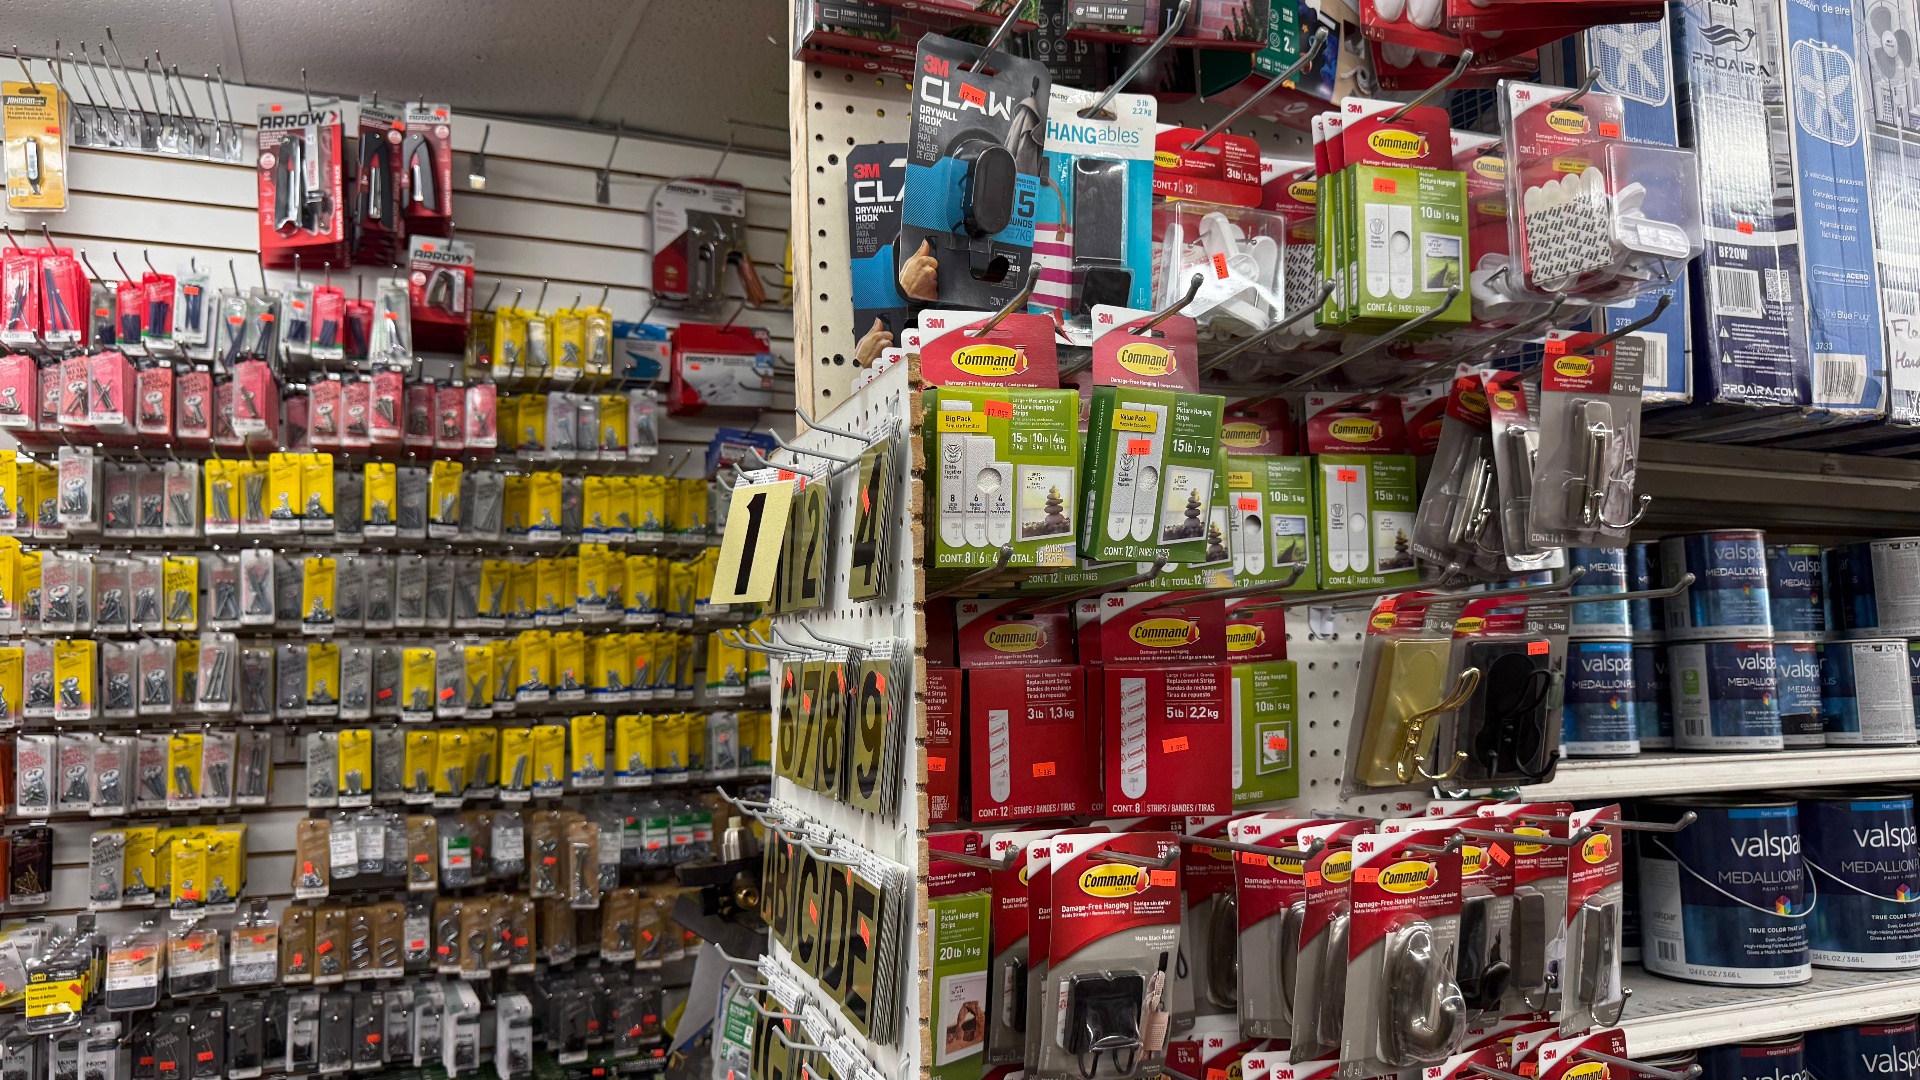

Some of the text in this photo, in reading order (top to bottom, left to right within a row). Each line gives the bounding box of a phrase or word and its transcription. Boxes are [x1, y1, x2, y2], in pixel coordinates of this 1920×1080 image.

[1822, 4, 1832, 14] de
[1834, 4, 1850, 16] aire
[924, 55, 950, 78] 3M
[1692, 52, 1771, 77] PROAIRA
[1516, 90, 1530, 100] 3M
[920, 104, 958, 122] DRYWALL
[1144, 108, 1152, 116] kg
[1348, 104, 1362, 114] 3M
[260, 111, 327, 130] ARROW
[919, 113, 942, 128] HOOK
[1550, 114, 1584, 128] Command
[1046, 118, 1140, 145] HANGables
[1372, 136, 1420, 151] Command
[1362, 159, 1391, 167] Damage-Free
[854, 163, 880, 178] 3M
[1152, 179, 1193, 194] CONT. 7 12
[1420, 177, 1436, 185] Picture
[855, 205, 894, 214] DRYWALL
[1420, 206, 1433, 218] 10
[1434, 208, 1441, 218] lb
[1450, 213, 1459, 222] kg
[856, 214, 879, 222] HOOK
[856, 222, 876, 230] GANCHO
[1015, 228, 1032, 242] 7KG
[414, 250, 464, 262] ARROW
[1718, 246, 1748, 261] BF20W
[1846, 273, 1869, 281] ACERO
[926, 318, 945, 329] 3M
[1098, 313, 1113, 324] 3M
[1815, 342, 1833, 350] 3733
[958, 352, 1016, 367] Command
[1121, 350, 1168, 366] Command
[1556, 360, 1588, 371] Command
[982, 380, 1004, 388] Hanging
[1111, 377, 1139, 385] Damage-Free
[1722, 383, 1797, 397] PROAIRA.COM
[1310, 397, 1323, 406] 3M
[1176, 414, 1190, 422] Strips
[1194, 408, 1212, 417] Hanging
[1220, 428, 1261, 440] Command
[1332, 424, 1374, 435] Command
[1012, 433, 1022, 443] 15
[1033, 433, 1043, 442] 10
[1053, 433, 1059, 443] 4
[1172, 439, 1210, 455] 15 lb 7 kg
[852, 452, 882, 586] 4
[734, 492, 767, 595] 1
[802, 490, 819, 599] 2
[940, 551, 1044, 563] CONT. 8 6 4 18
[1104, 546, 1133, 557] CONT. 12
[1107, 598, 1124, 607] 3M
[1455, 621, 1482, 629] Command
[989, 631, 1038, 644] Command
[1135, 626, 1189, 639] Command
[1572, 678, 1627, 689] MEDALLION
[781, 669, 796, 770] 6
[1027, 708, 1074, 720] 3 lb 1,3 kg
[1166, 707, 1219, 720] 5 lb 2,2 kg
[798, 671, 821, 778] 7
[823, 671, 839, 790] 8
[857, 671, 882, 799] 9
[978, 803, 1075, 817] CONT. 12 STRIPS BANDES TIRAS
[1135, 804, 1140, 813] 8
[1147, 805, 1167, 813] STRIPS
[1172, 804, 1194, 812] BANDES
[1198, 804, 1215, 812] TIRAS
[1056, 843, 1073, 853] 3M
[1357, 842, 1374, 852] 3M
[1084, 874, 1138, 888] Command
[1382, 870, 1428, 884] Command
[1718, 872, 1796, 884] MEDALLION
[775, 835, 789, 937] B
[796, 850, 818, 964] C
[1061, 902, 1129, 912] Damage-Free Hanging
[1354, 897, 1415, 909] Damage-Free Hanging
[958, 912, 979, 920] Hanging
[823, 866, 848, 990] D
[846, 886, 875, 1024] E
[940, 947, 980, 960] 20 lb 9 kg
[1689, 968, 1698, 976] 124
